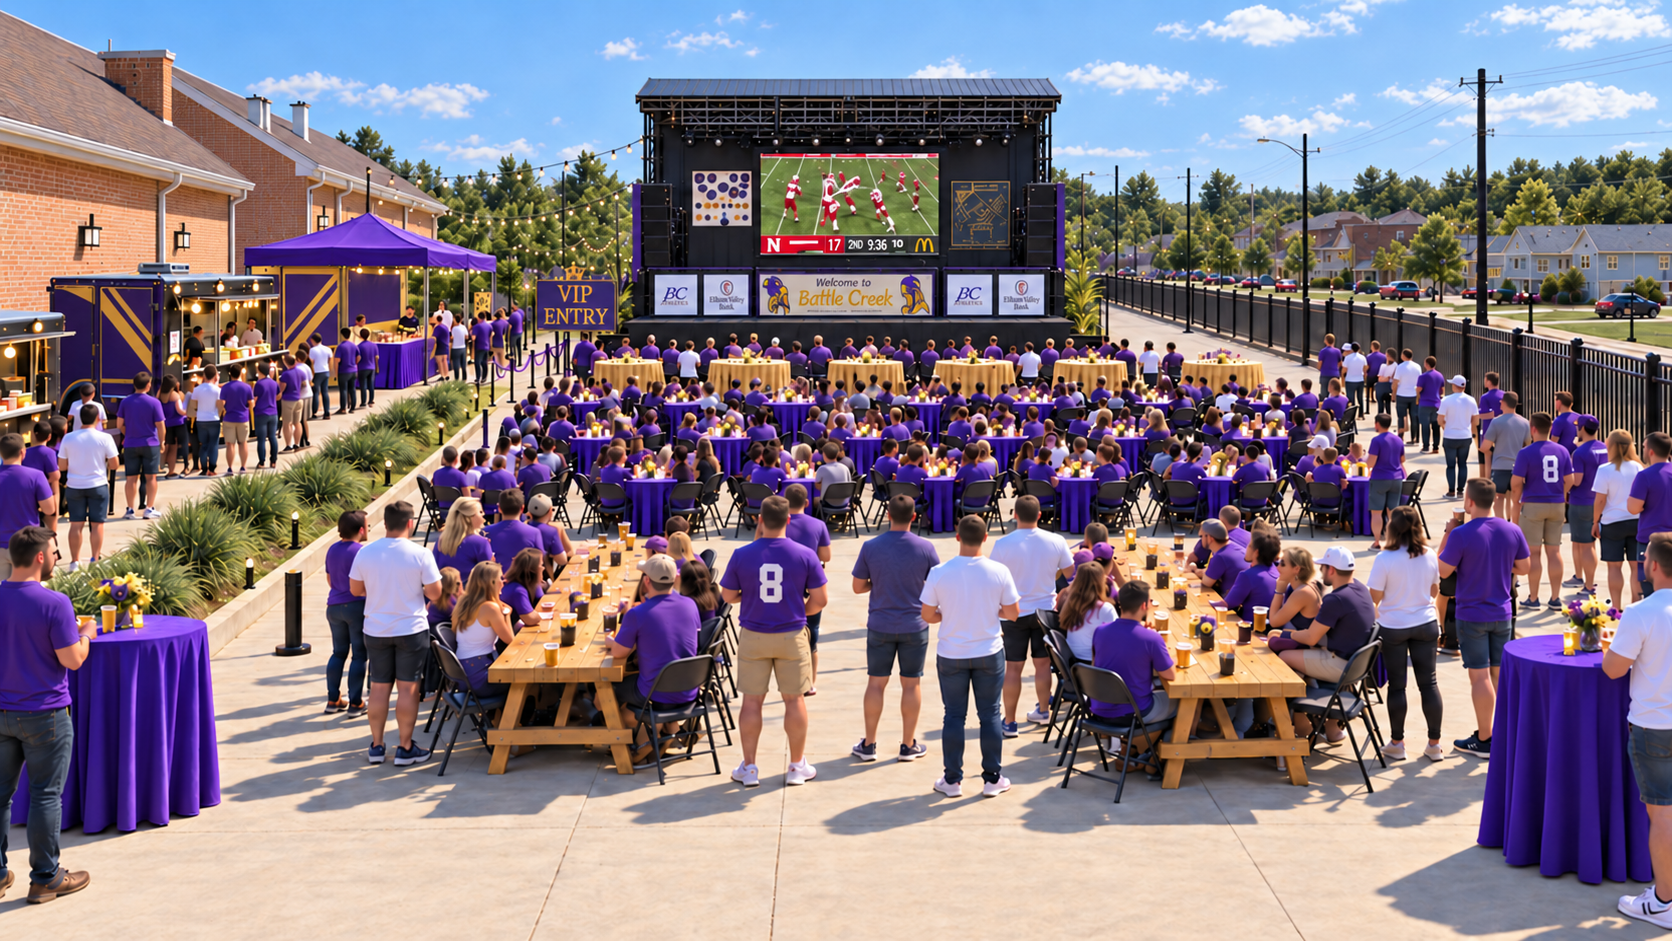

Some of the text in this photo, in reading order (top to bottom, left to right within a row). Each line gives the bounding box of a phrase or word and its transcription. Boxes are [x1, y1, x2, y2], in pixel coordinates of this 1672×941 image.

[767, 238, 781, 252] N
[828, 238, 842, 251] 17
[848, 239, 863, 250] 2ND
[891, 239, 904, 248] 10
[816, 277, 872, 287] Welcome to
[557, 284, 593, 303] VIP
[662, 286, 688, 302] BC
[798, 288, 893, 307] Battle Creek
[955, 286, 982, 302] BC
[543, 307, 609, 325] ENTRY
[1542, 455, 1559, 483] 8
[759, 563, 783, 603] 8
